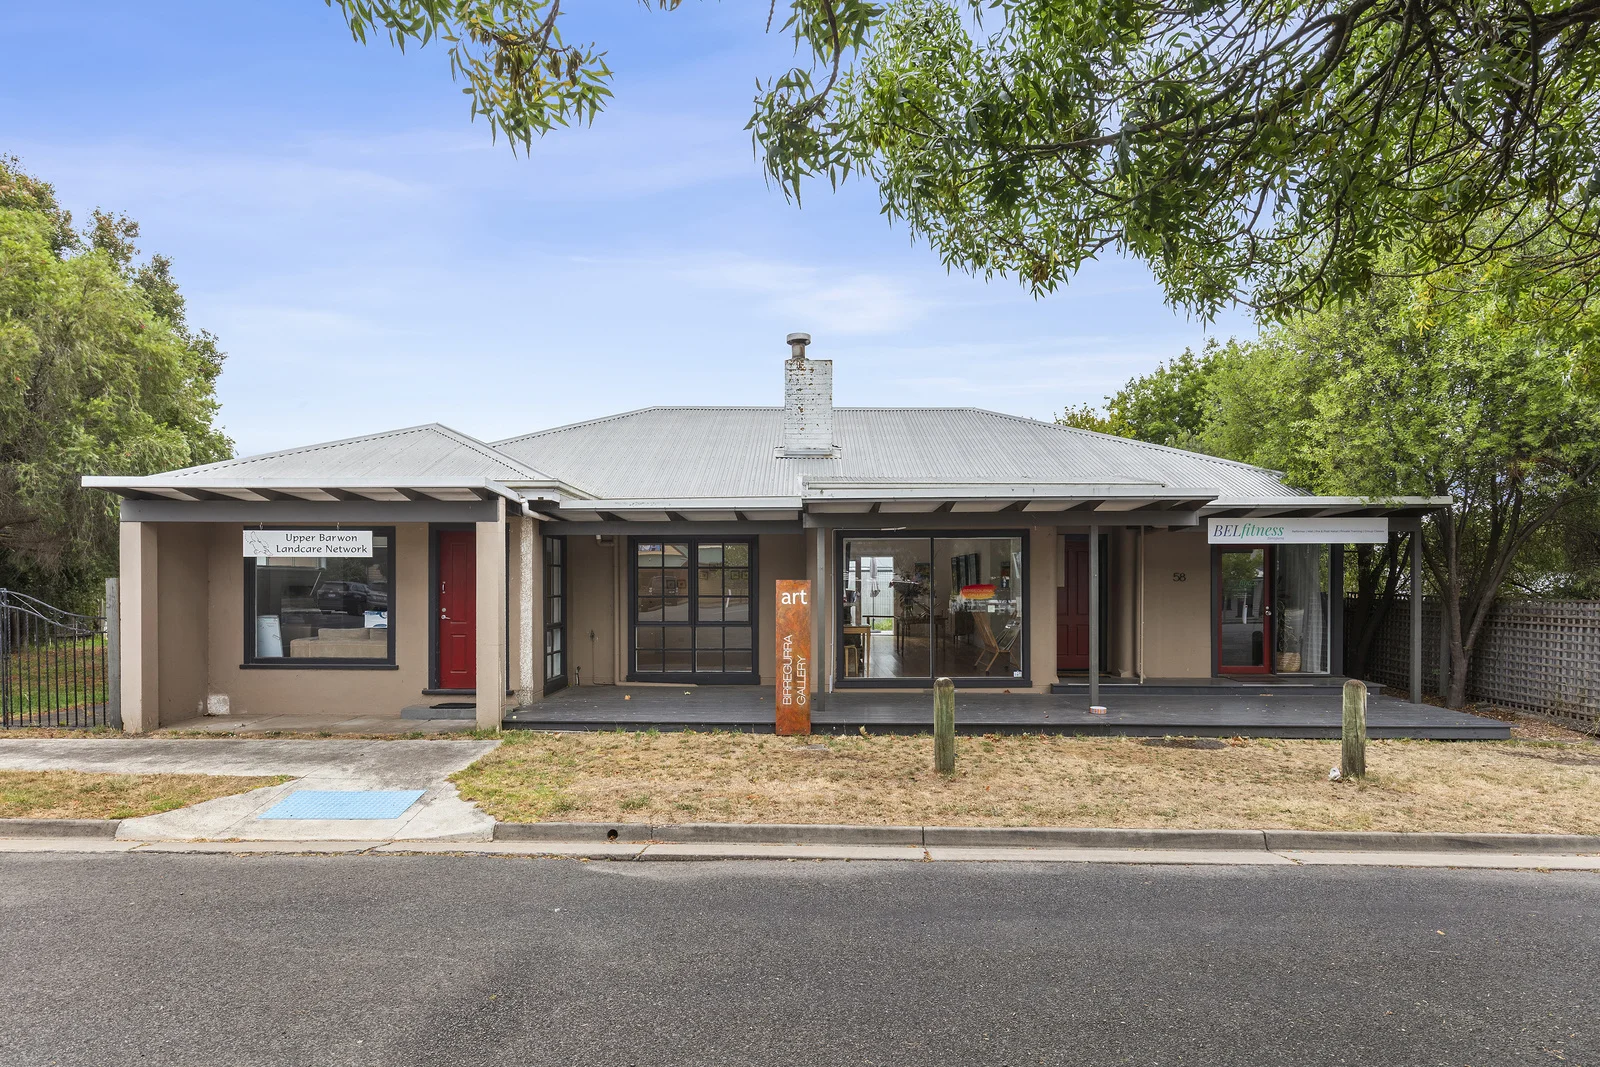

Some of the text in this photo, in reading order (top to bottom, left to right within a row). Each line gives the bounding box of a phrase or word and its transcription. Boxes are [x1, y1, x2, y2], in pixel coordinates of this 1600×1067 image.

[285, 533, 358, 543] Upper Barwon
[1213, 522, 1285, 539] BELfitness
[276, 545, 368, 553] Landcare Network
[1172, 572, 1187, 582] 58
[781, 589, 808, 605] art
[782, 634, 793, 705] BIRREGURRA
[796, 654, 806, 706] GALLERY
